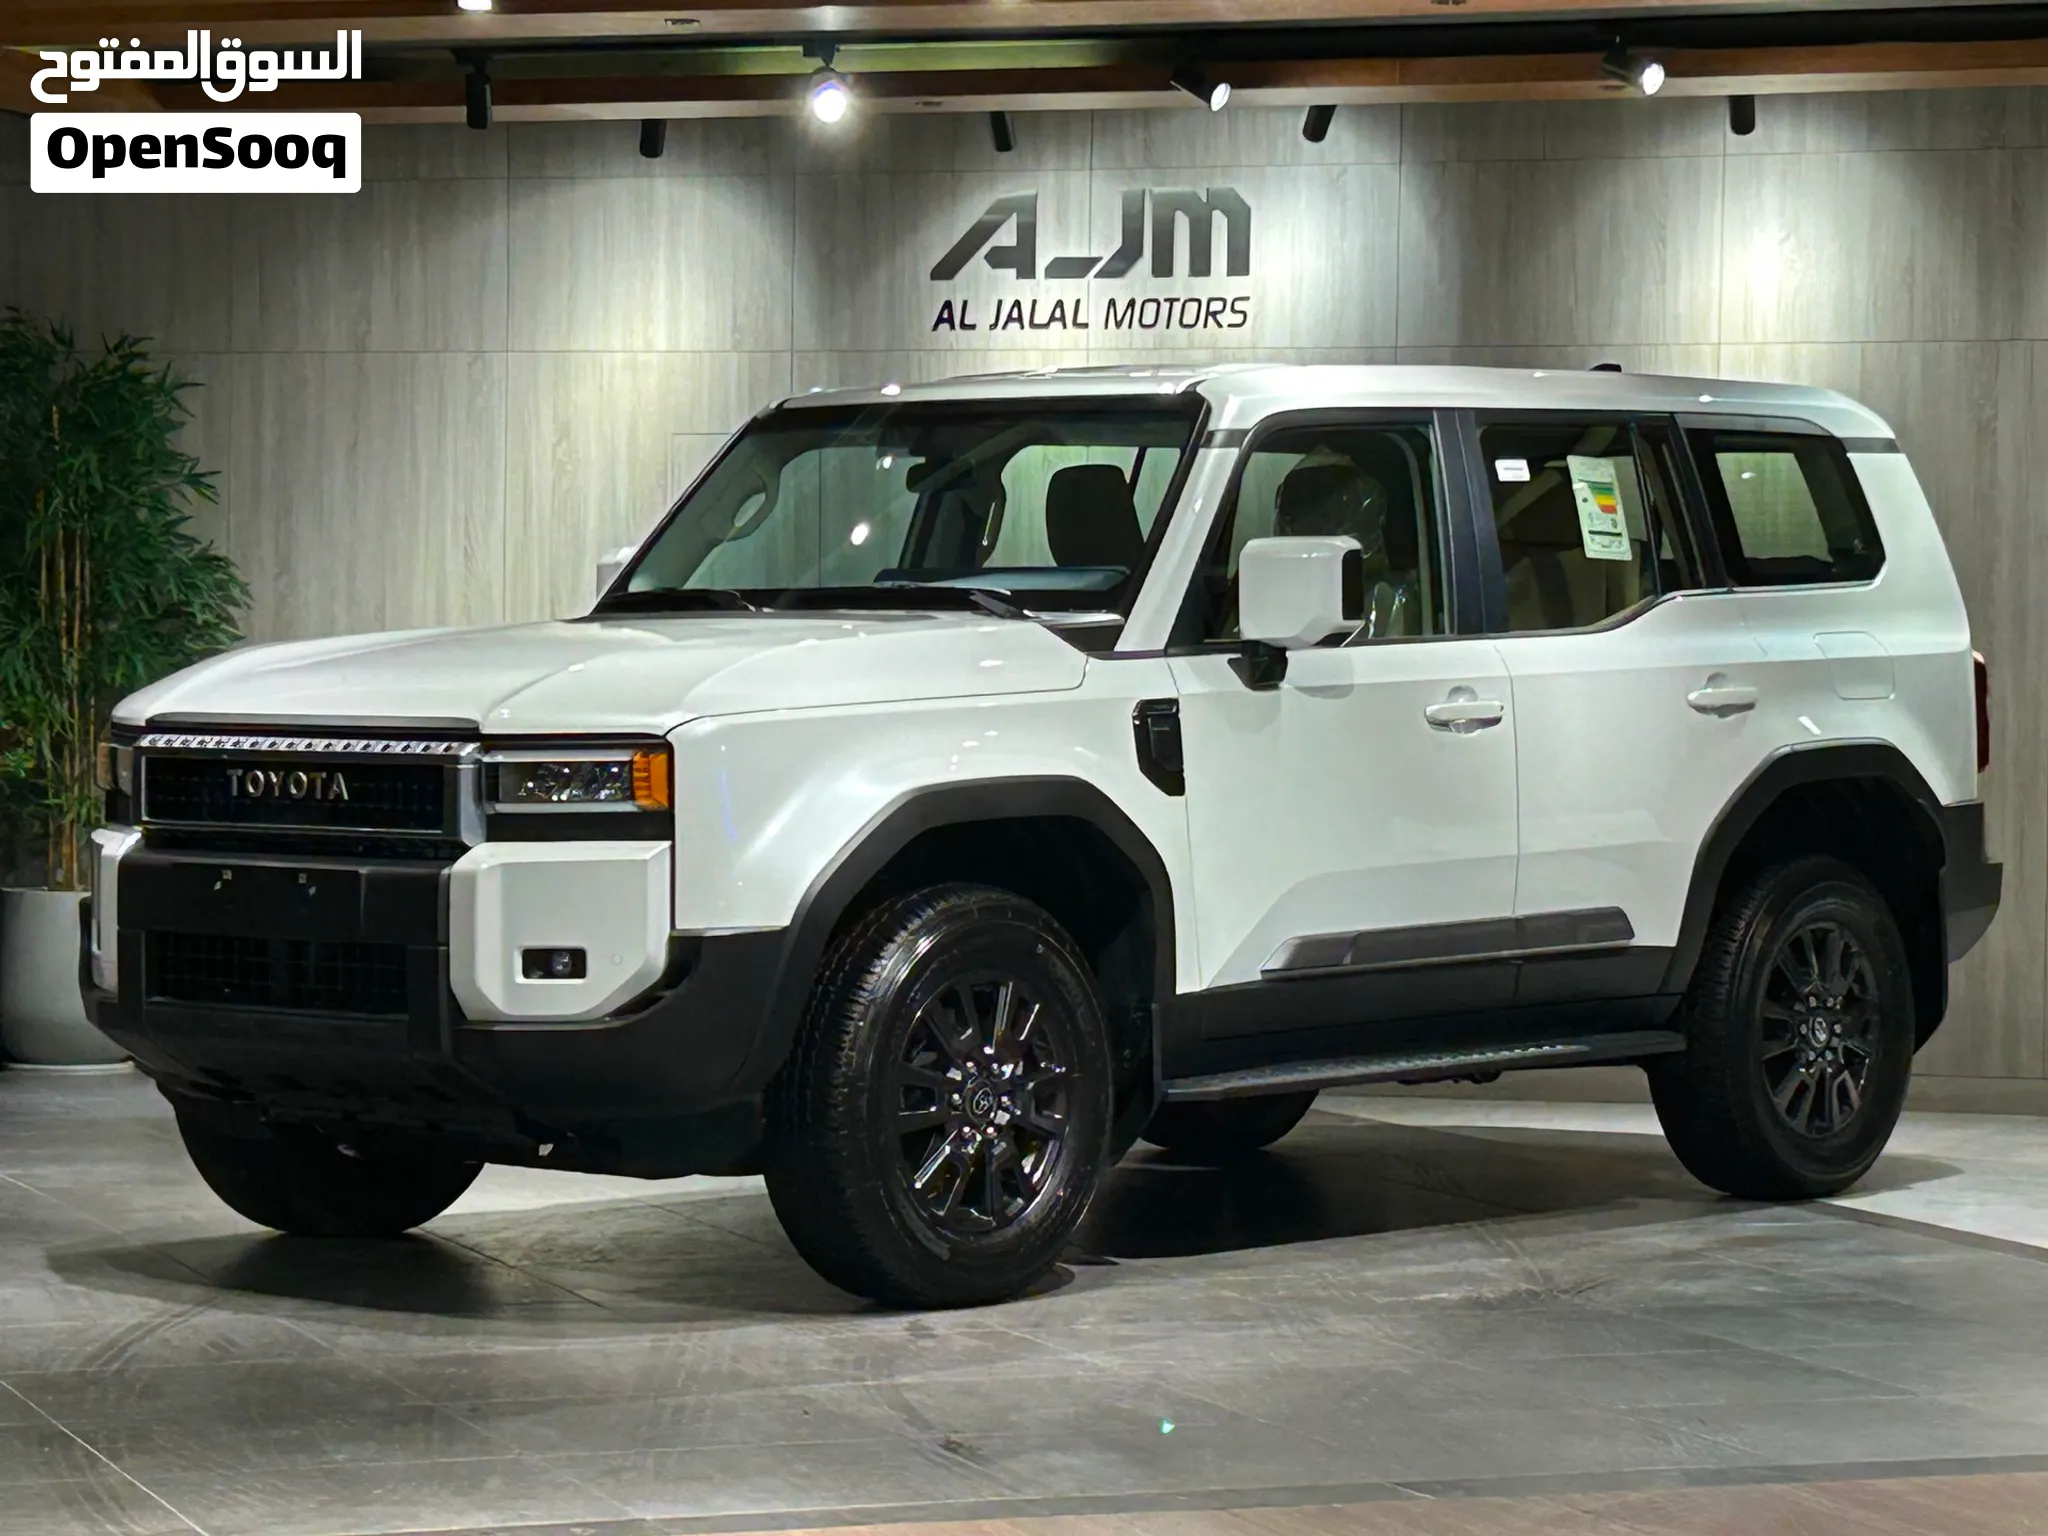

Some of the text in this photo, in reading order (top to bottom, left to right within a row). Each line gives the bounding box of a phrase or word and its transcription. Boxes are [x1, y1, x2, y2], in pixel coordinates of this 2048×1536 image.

[931, 296, 1251, 332] AL JALAL MOTORS
[226, 769, 349, 800] TOYOTA
